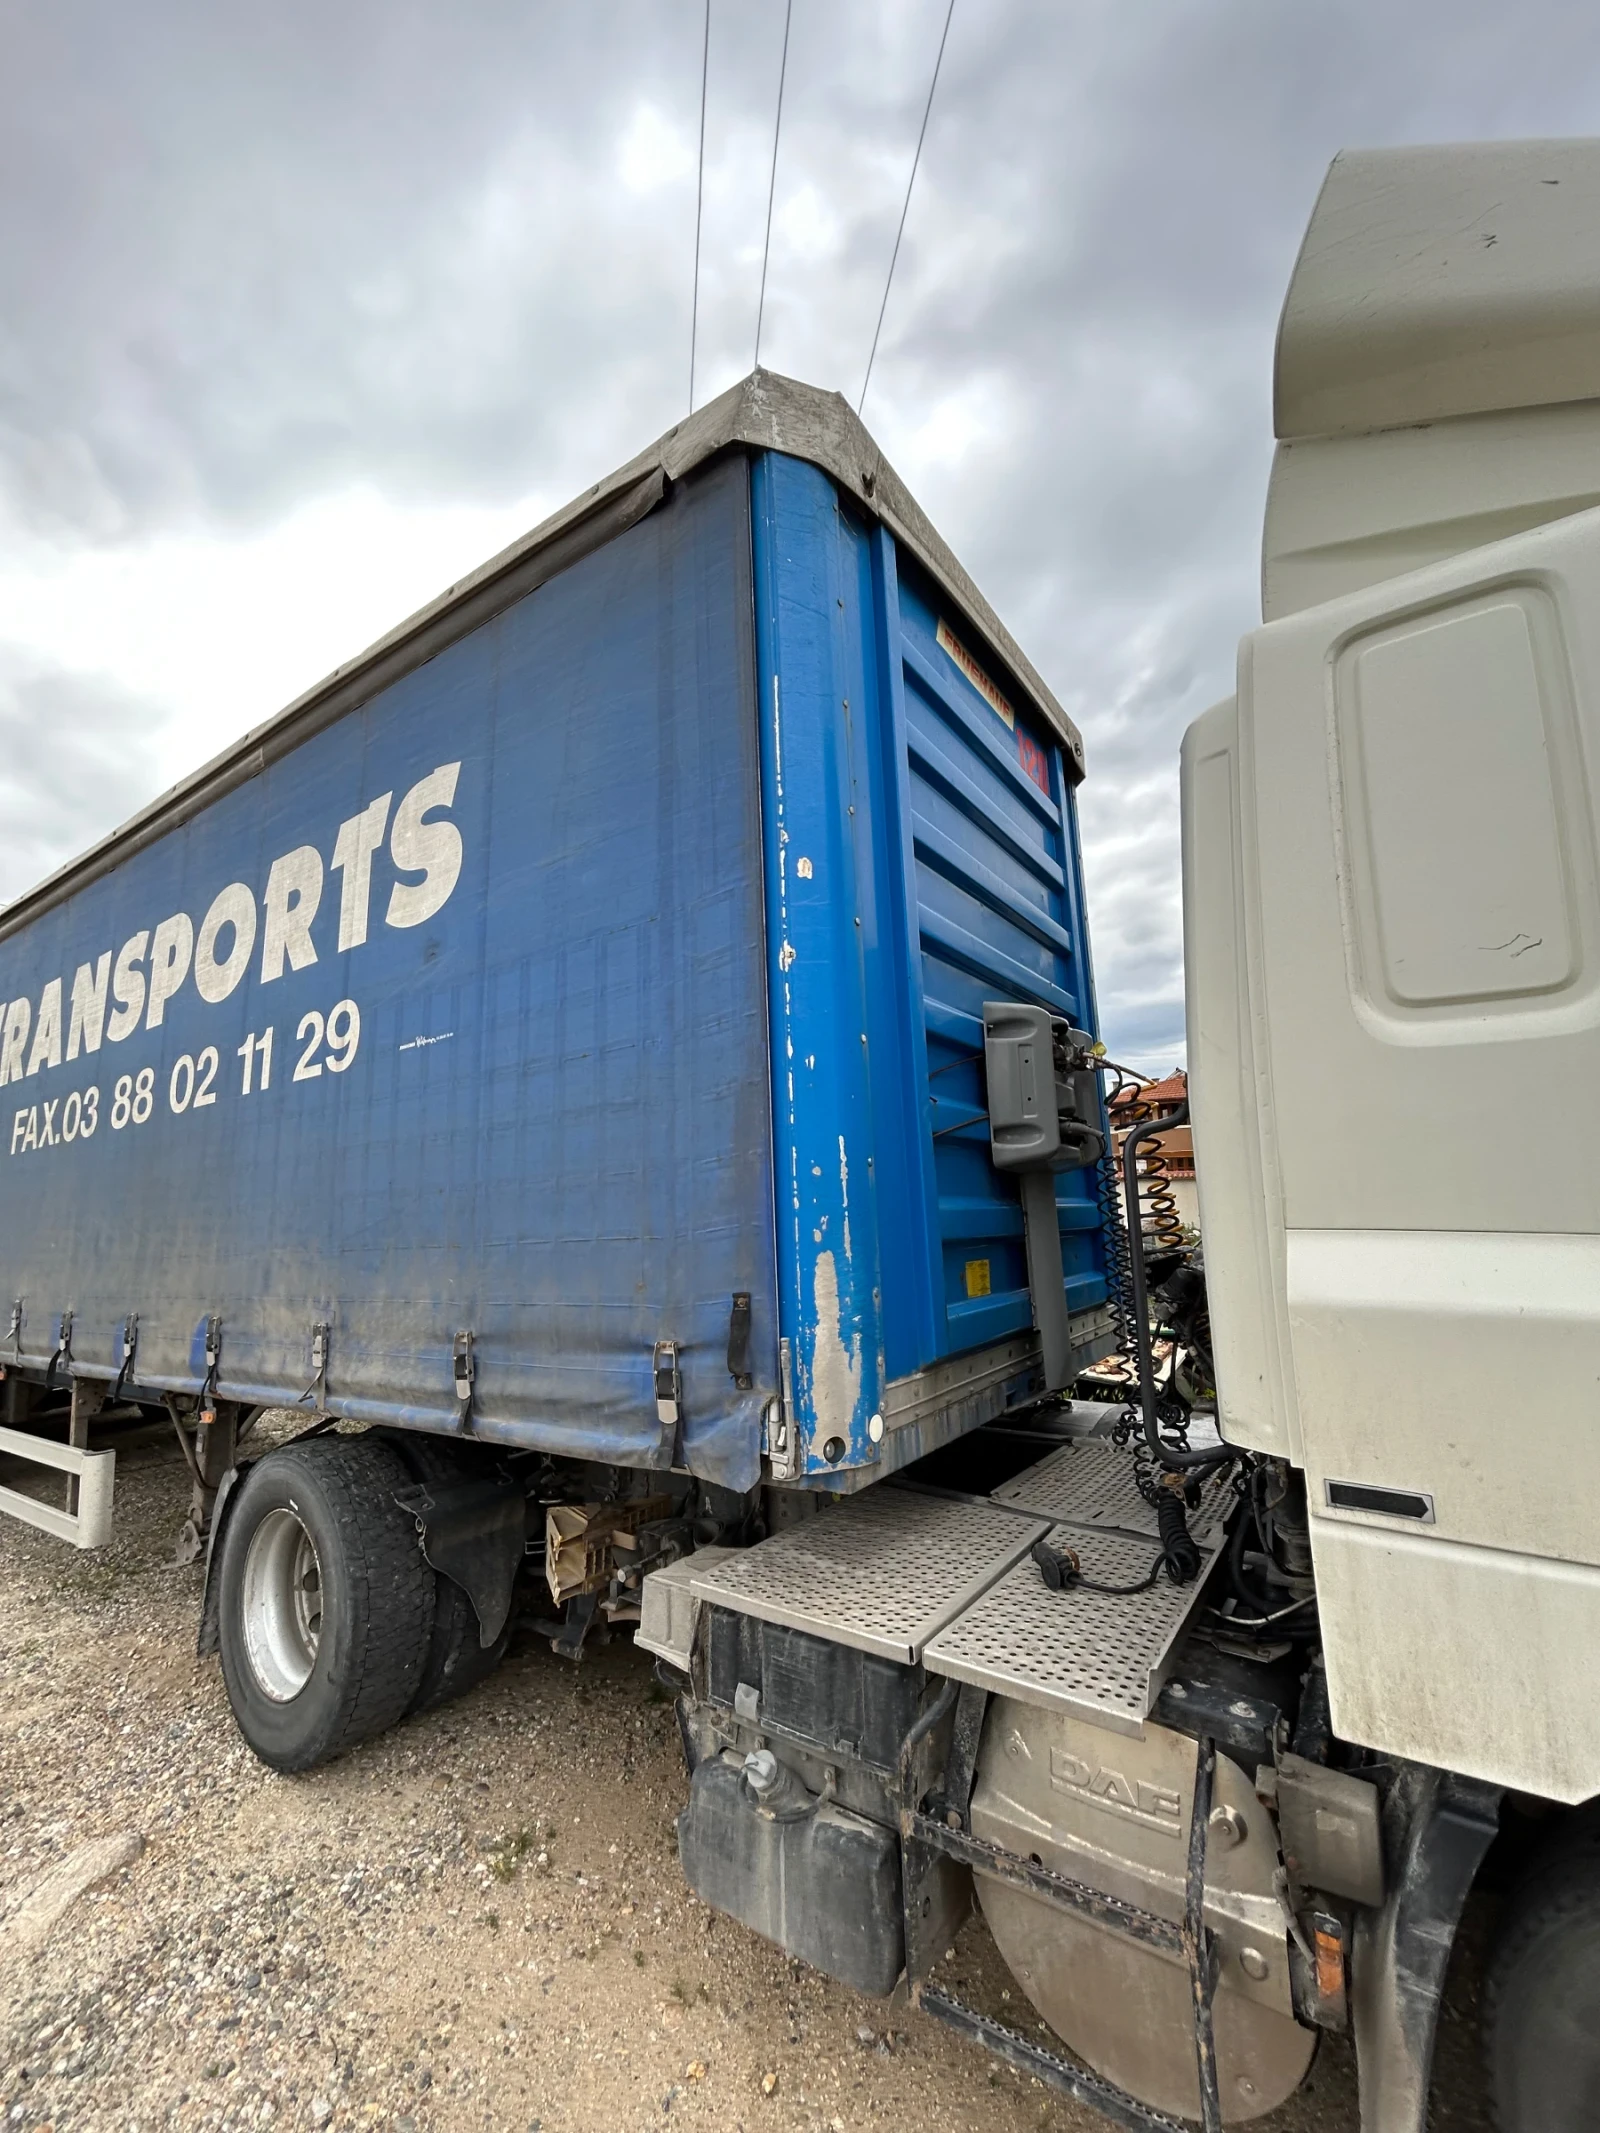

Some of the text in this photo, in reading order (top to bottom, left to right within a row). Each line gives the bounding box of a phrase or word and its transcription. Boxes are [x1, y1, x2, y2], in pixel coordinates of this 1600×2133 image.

[943, 628, 1011, 717] FRUEHAUF
[10, 998, 361, 1156] FAX.03 88 02 11 29
[1050, 1746, 1182, 1817] DAF
